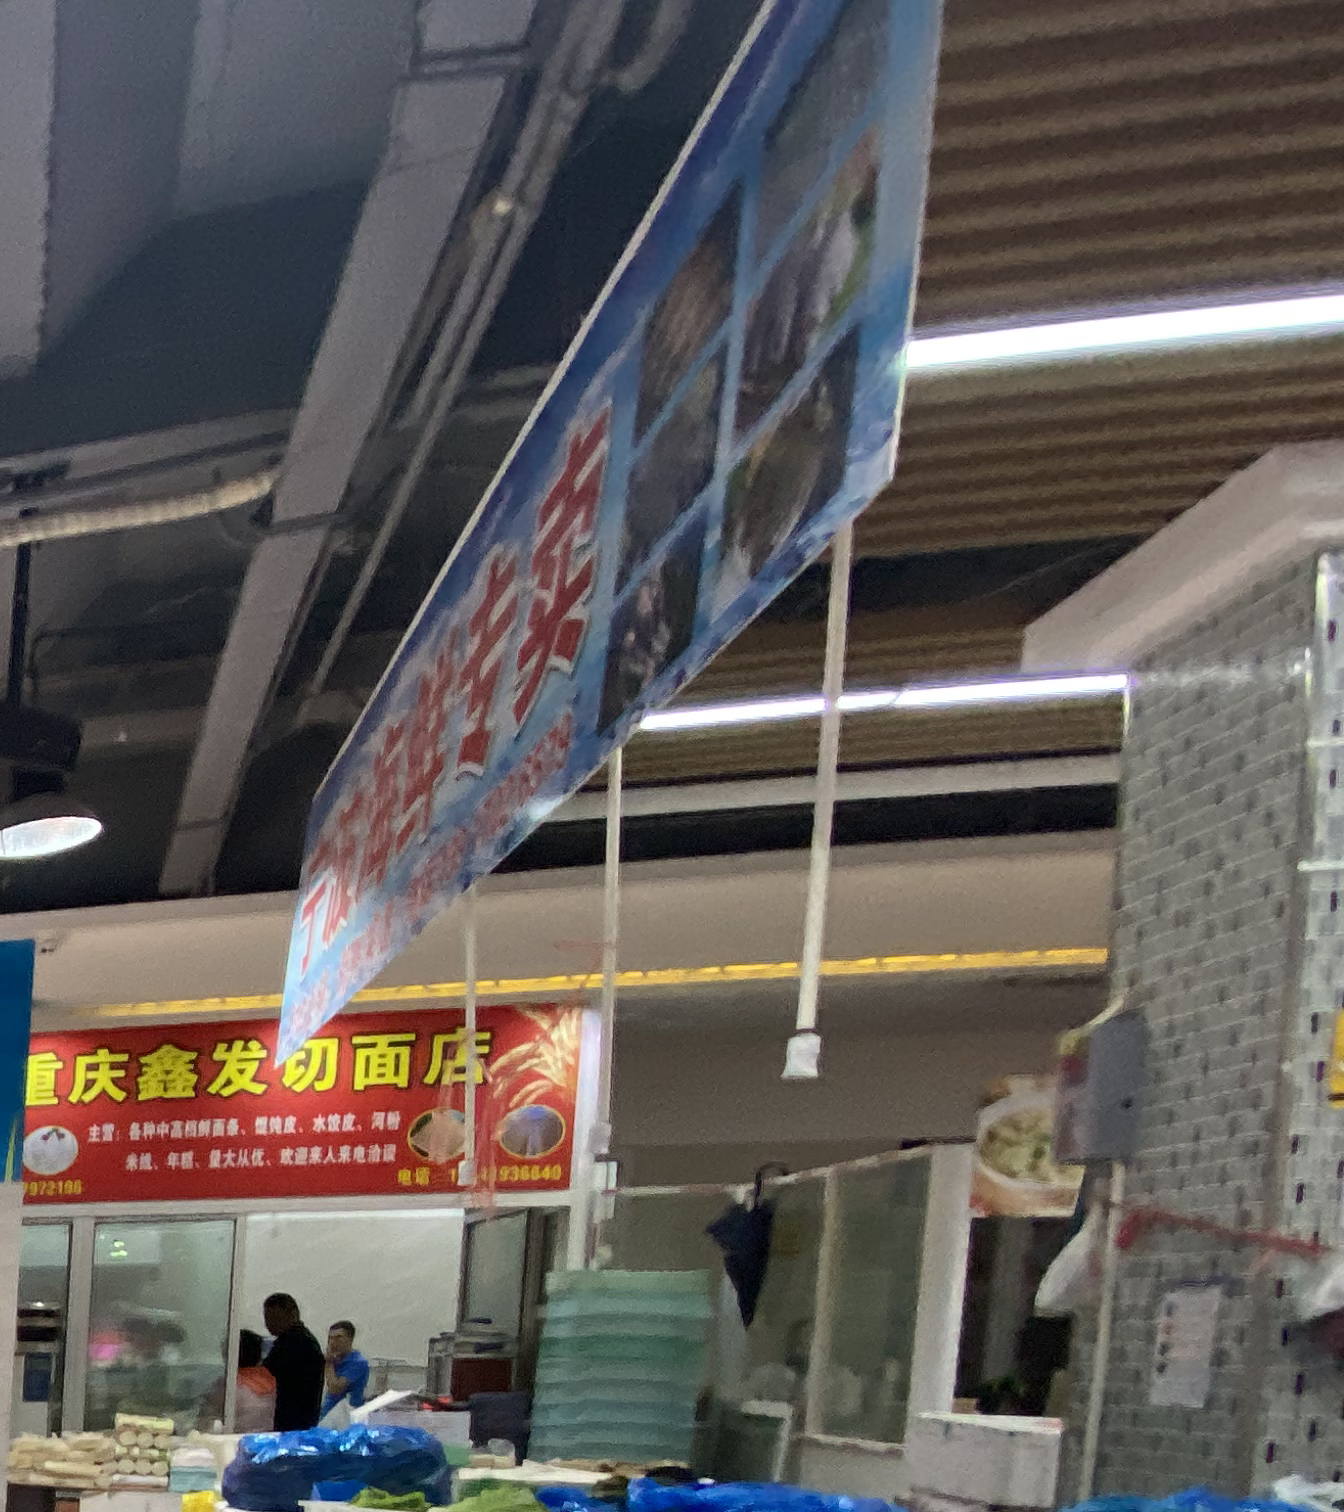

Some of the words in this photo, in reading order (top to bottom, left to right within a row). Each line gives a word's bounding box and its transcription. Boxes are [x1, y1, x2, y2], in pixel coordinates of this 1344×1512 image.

[23, 1024, 494, 1108] 重庆鑫发切面店
